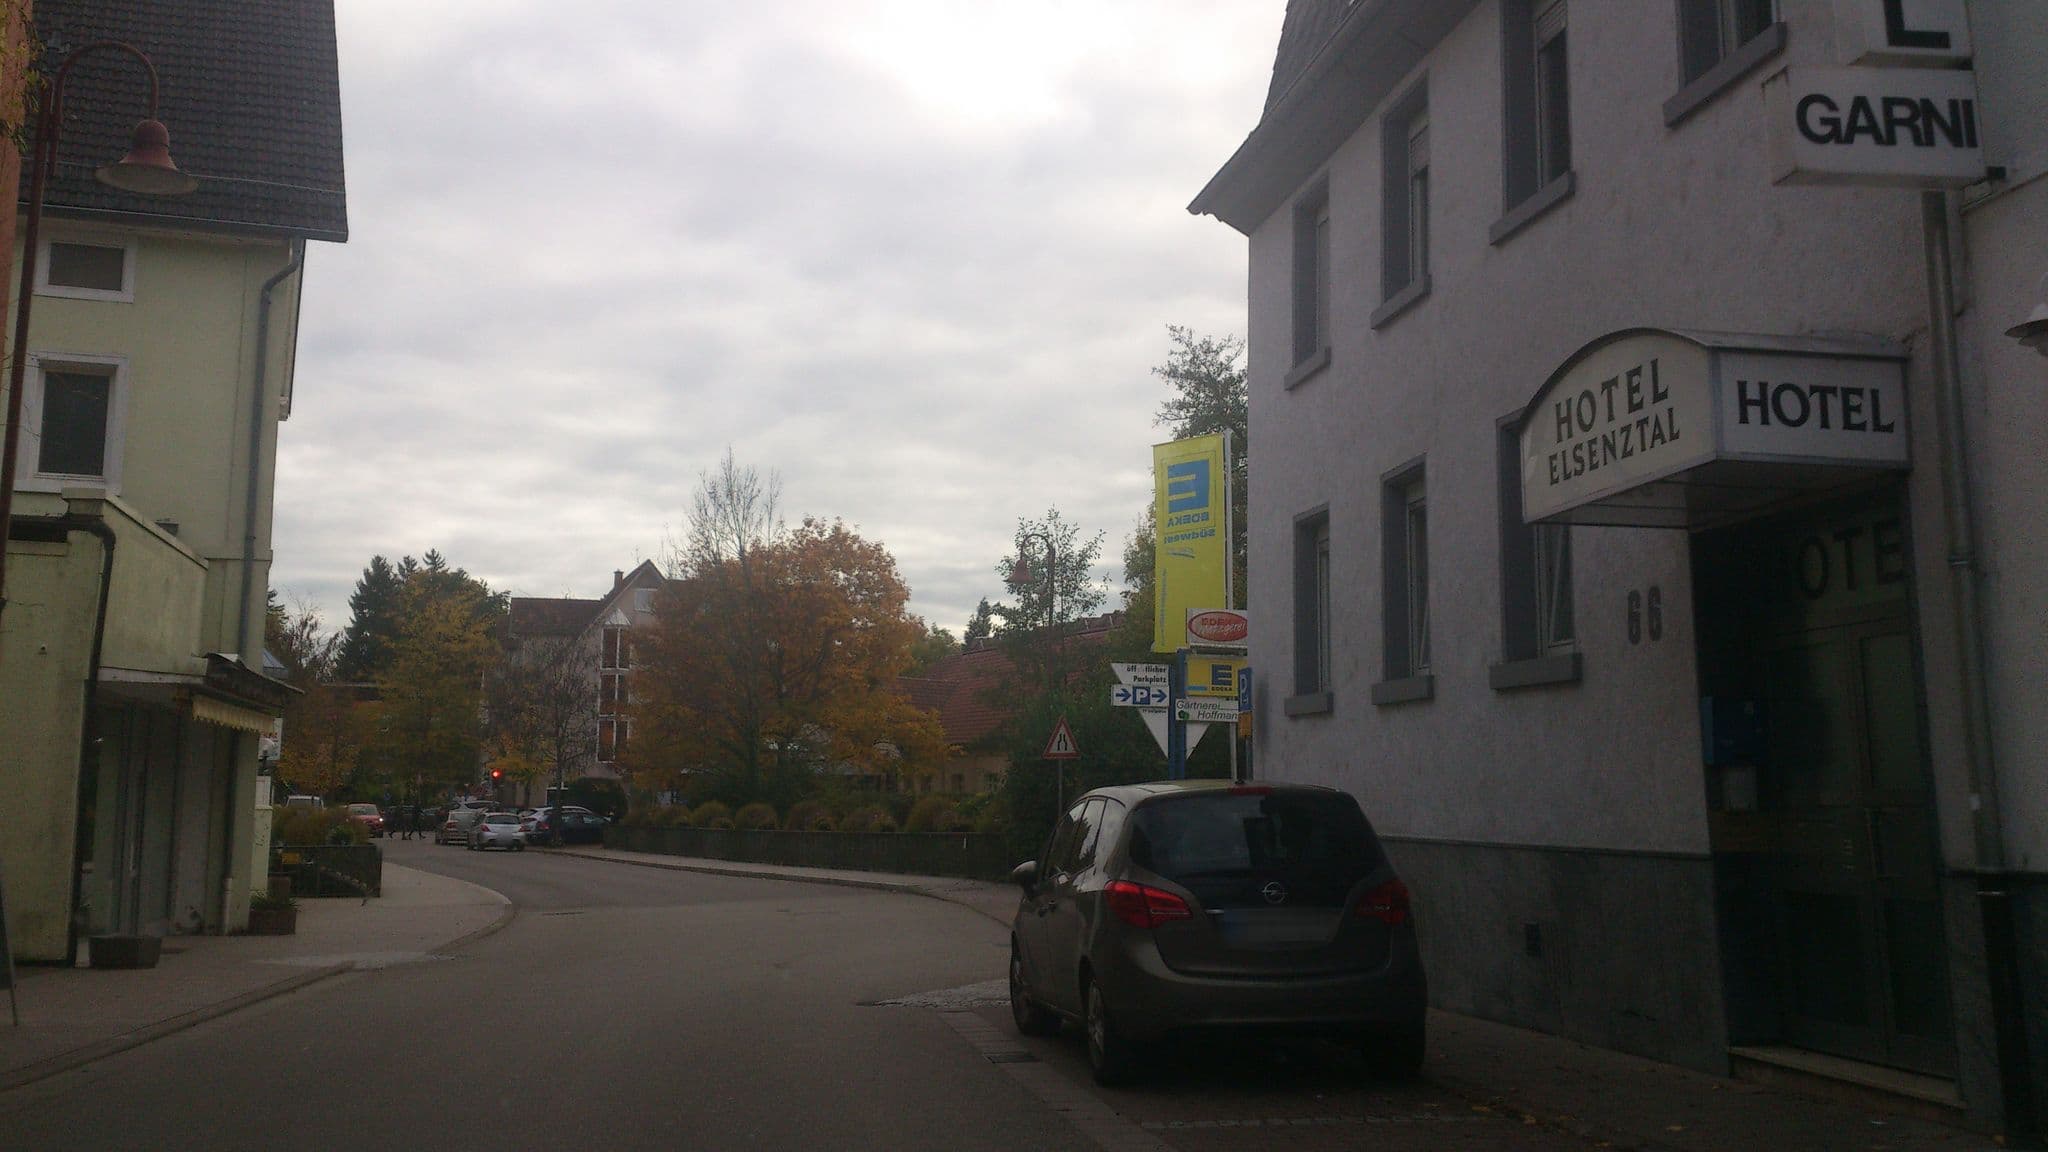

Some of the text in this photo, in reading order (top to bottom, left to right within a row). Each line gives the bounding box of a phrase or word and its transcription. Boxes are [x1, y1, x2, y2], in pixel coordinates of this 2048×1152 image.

[1796, 94, 1978, 148] GARNI
[1555, 358, 1669, 444] HOTEL
[1736, 380, 1895, 433] HOTEL
[1548, 407, 1680, 485] ELSENZTAL
[1798, 518, 1906, 599] OTE
[1628, 586, 1662, 646] 66
[1133, 675, 1166, 683] Parkplatz
